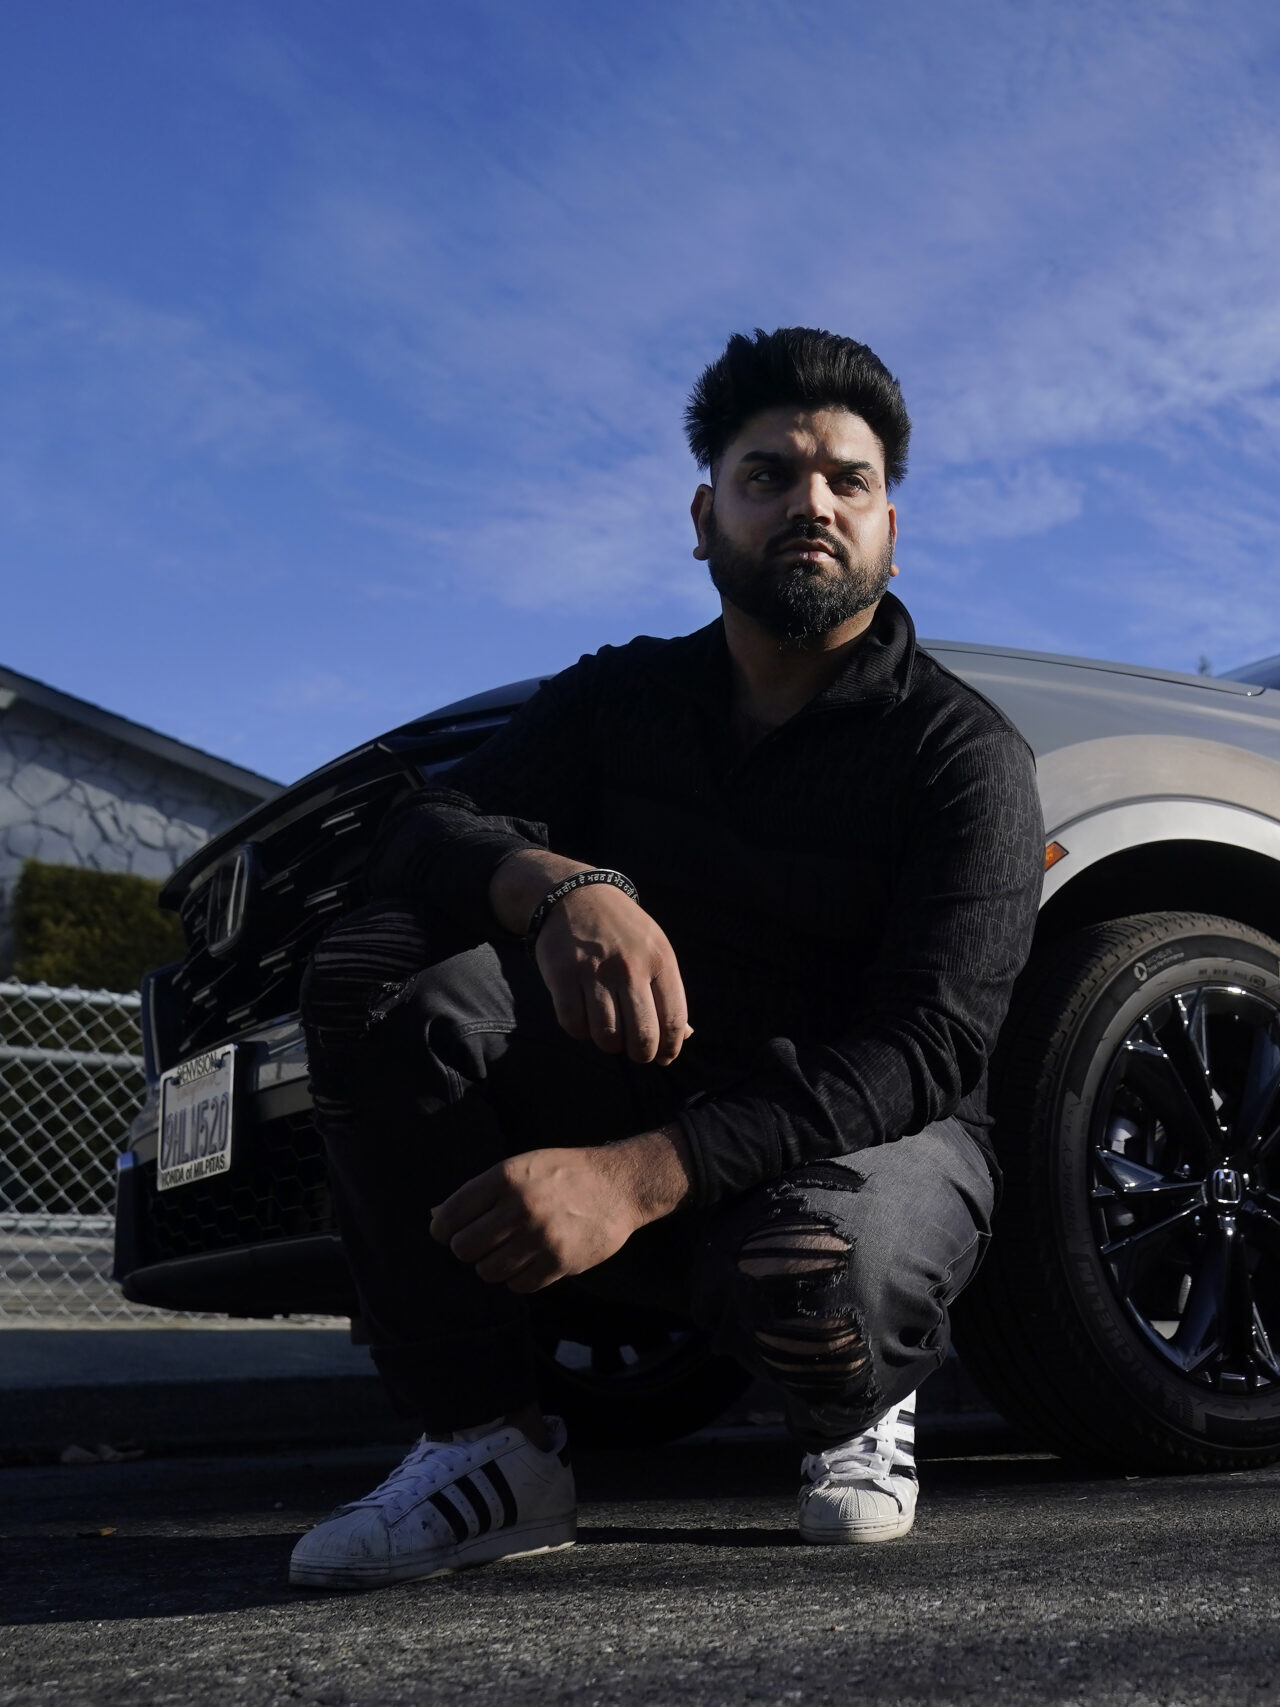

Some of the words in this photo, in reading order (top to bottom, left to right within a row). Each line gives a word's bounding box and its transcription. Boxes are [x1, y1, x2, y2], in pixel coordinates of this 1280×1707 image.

[160, 1167, 184, 1188] HONDA
[185, 1163, 193, 1181] of
[193, 1154, 226, 1178] MILPITAS
